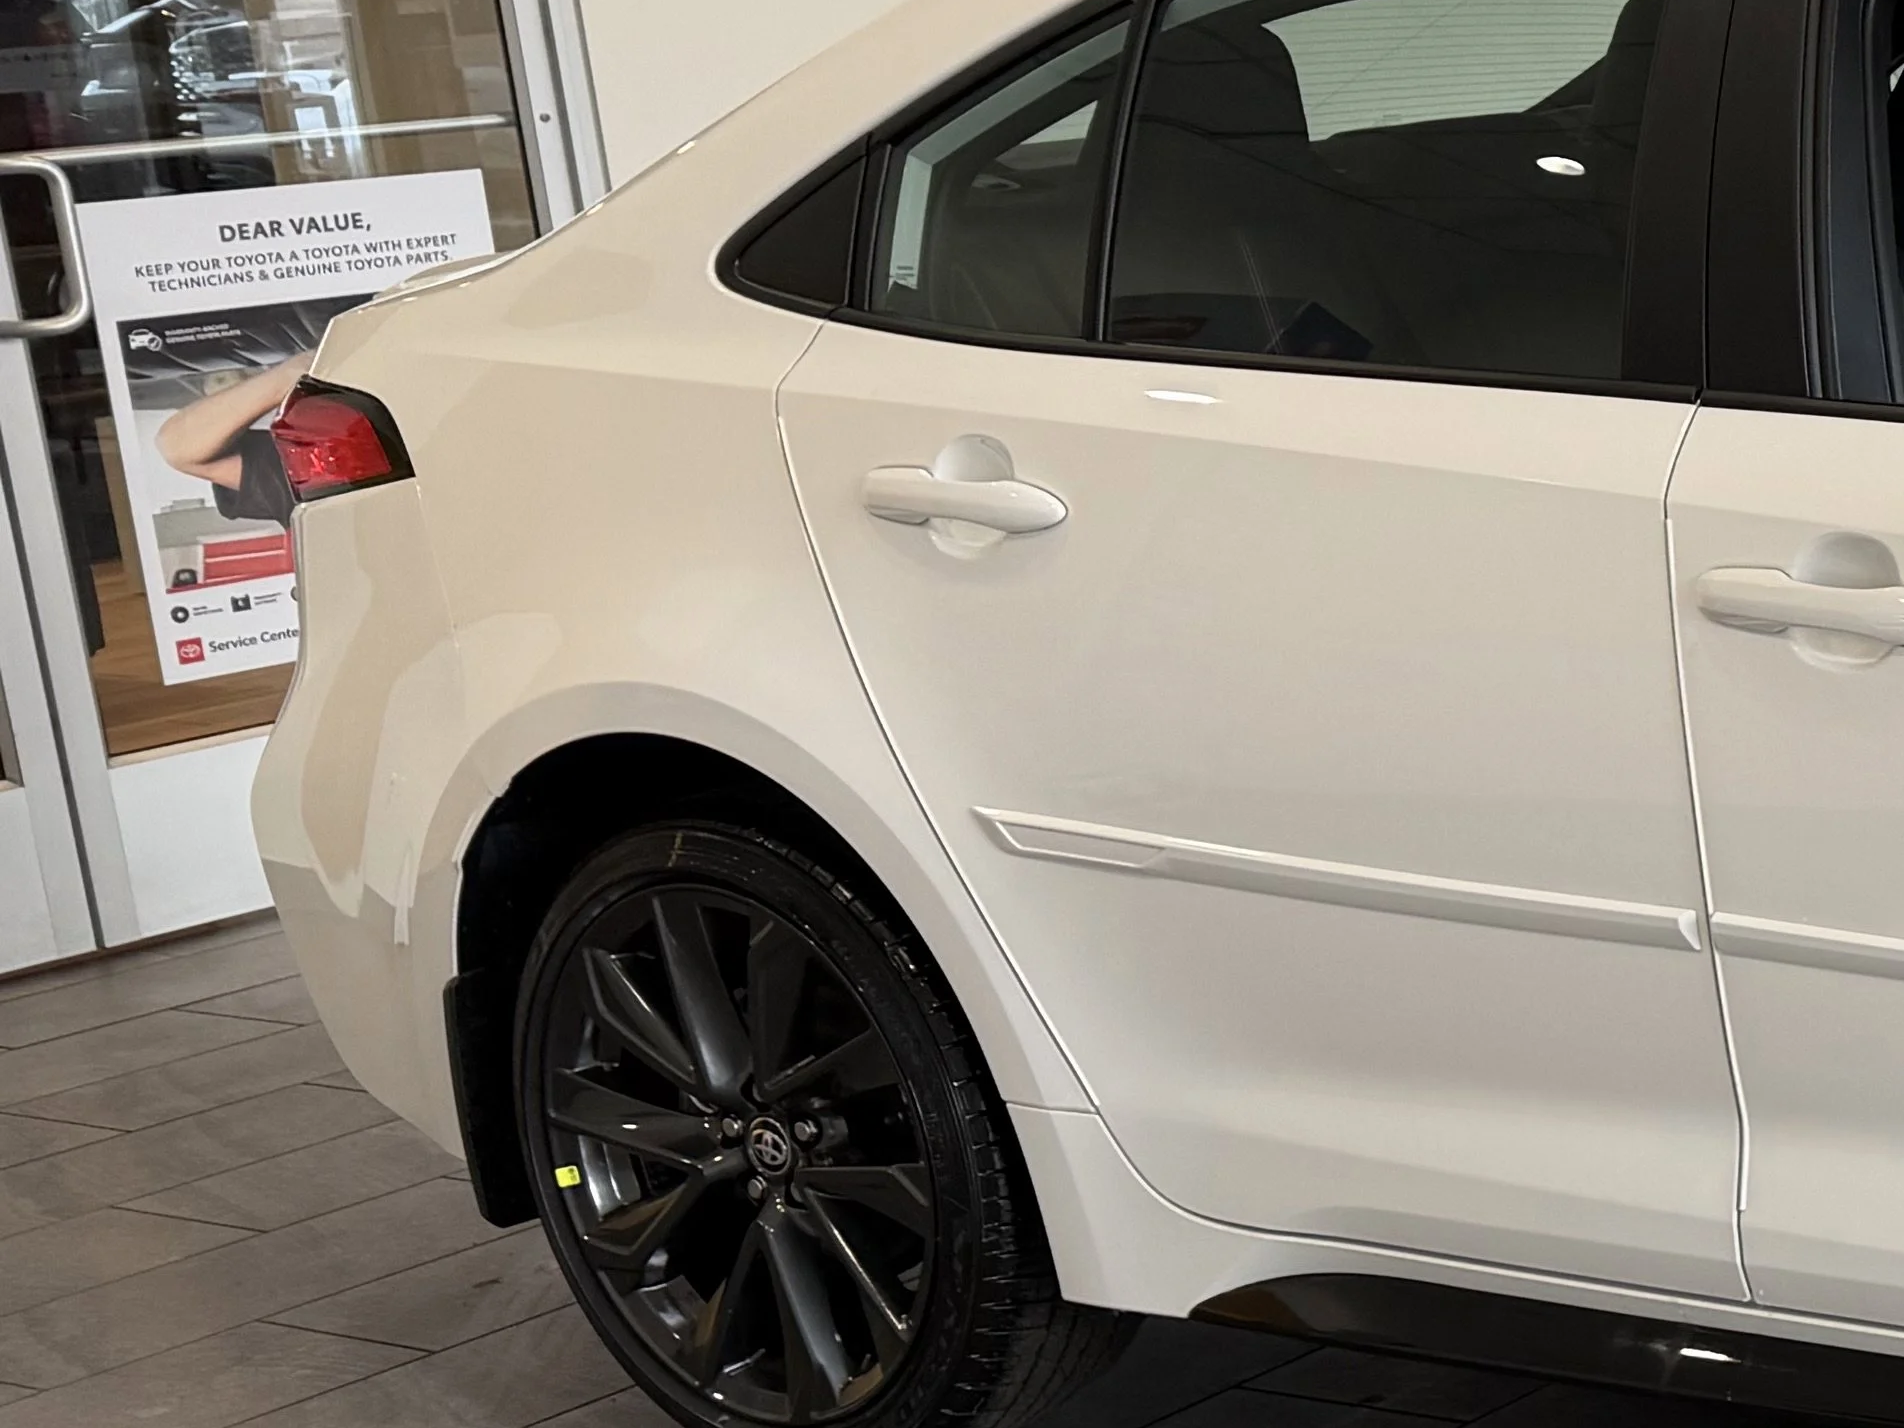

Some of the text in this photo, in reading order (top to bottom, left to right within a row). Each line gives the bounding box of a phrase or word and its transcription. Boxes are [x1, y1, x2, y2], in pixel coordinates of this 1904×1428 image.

[218, 211, 371, 243] DEAR VALUE,
[134, 233, 457, 279] KEEP YOUR TOYOTA A TOYOTA WITH EXPERT
[147, 249, 454, 294] TECHNICIANS & GENUINE TOYOTA PARTS.
[208, 628, 300, 653] Service Cente
